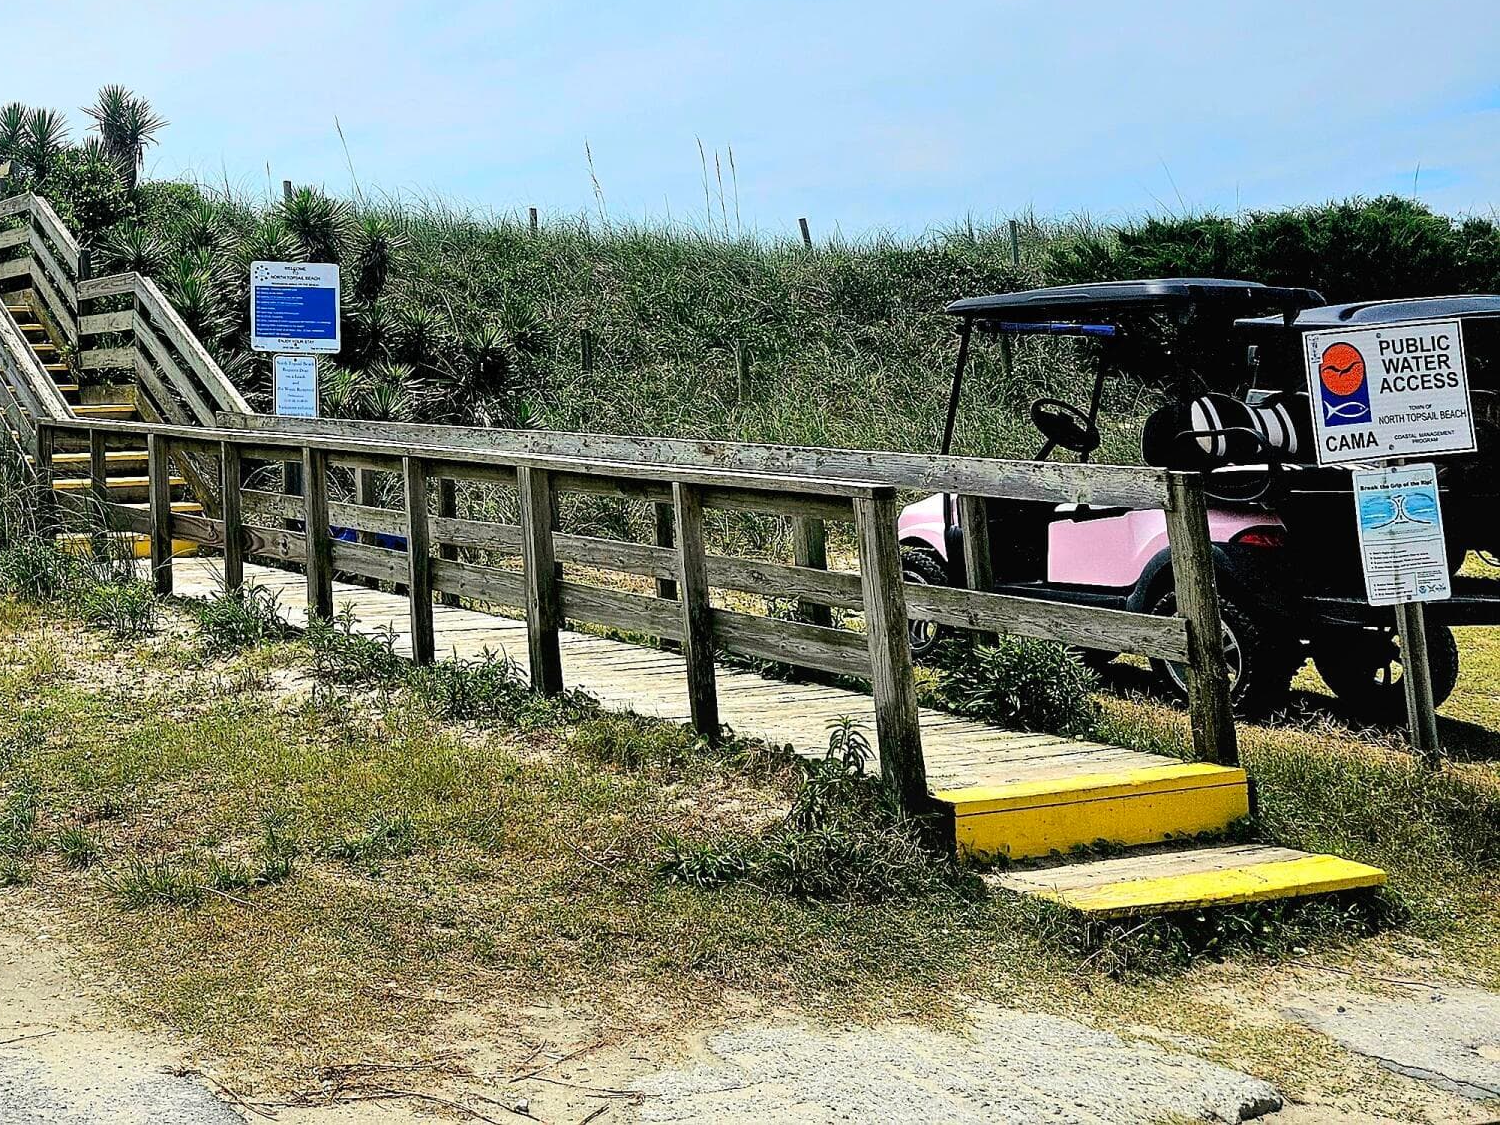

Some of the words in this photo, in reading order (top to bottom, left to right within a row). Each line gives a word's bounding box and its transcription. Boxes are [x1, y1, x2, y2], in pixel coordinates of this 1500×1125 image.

[1378, 335, 1450, 355] PUBLIC
[1382, 354, 1452, 374] WATER
[1380, 372, 1459, 394] ACCESS
[1378, 413, 1404, 425] NORTH
[1406, 411, 1438, 423] TOPSAIL
[1440, 409, 1467, 419] BEACH
[1325, 431, 1379, 452] CAMA
